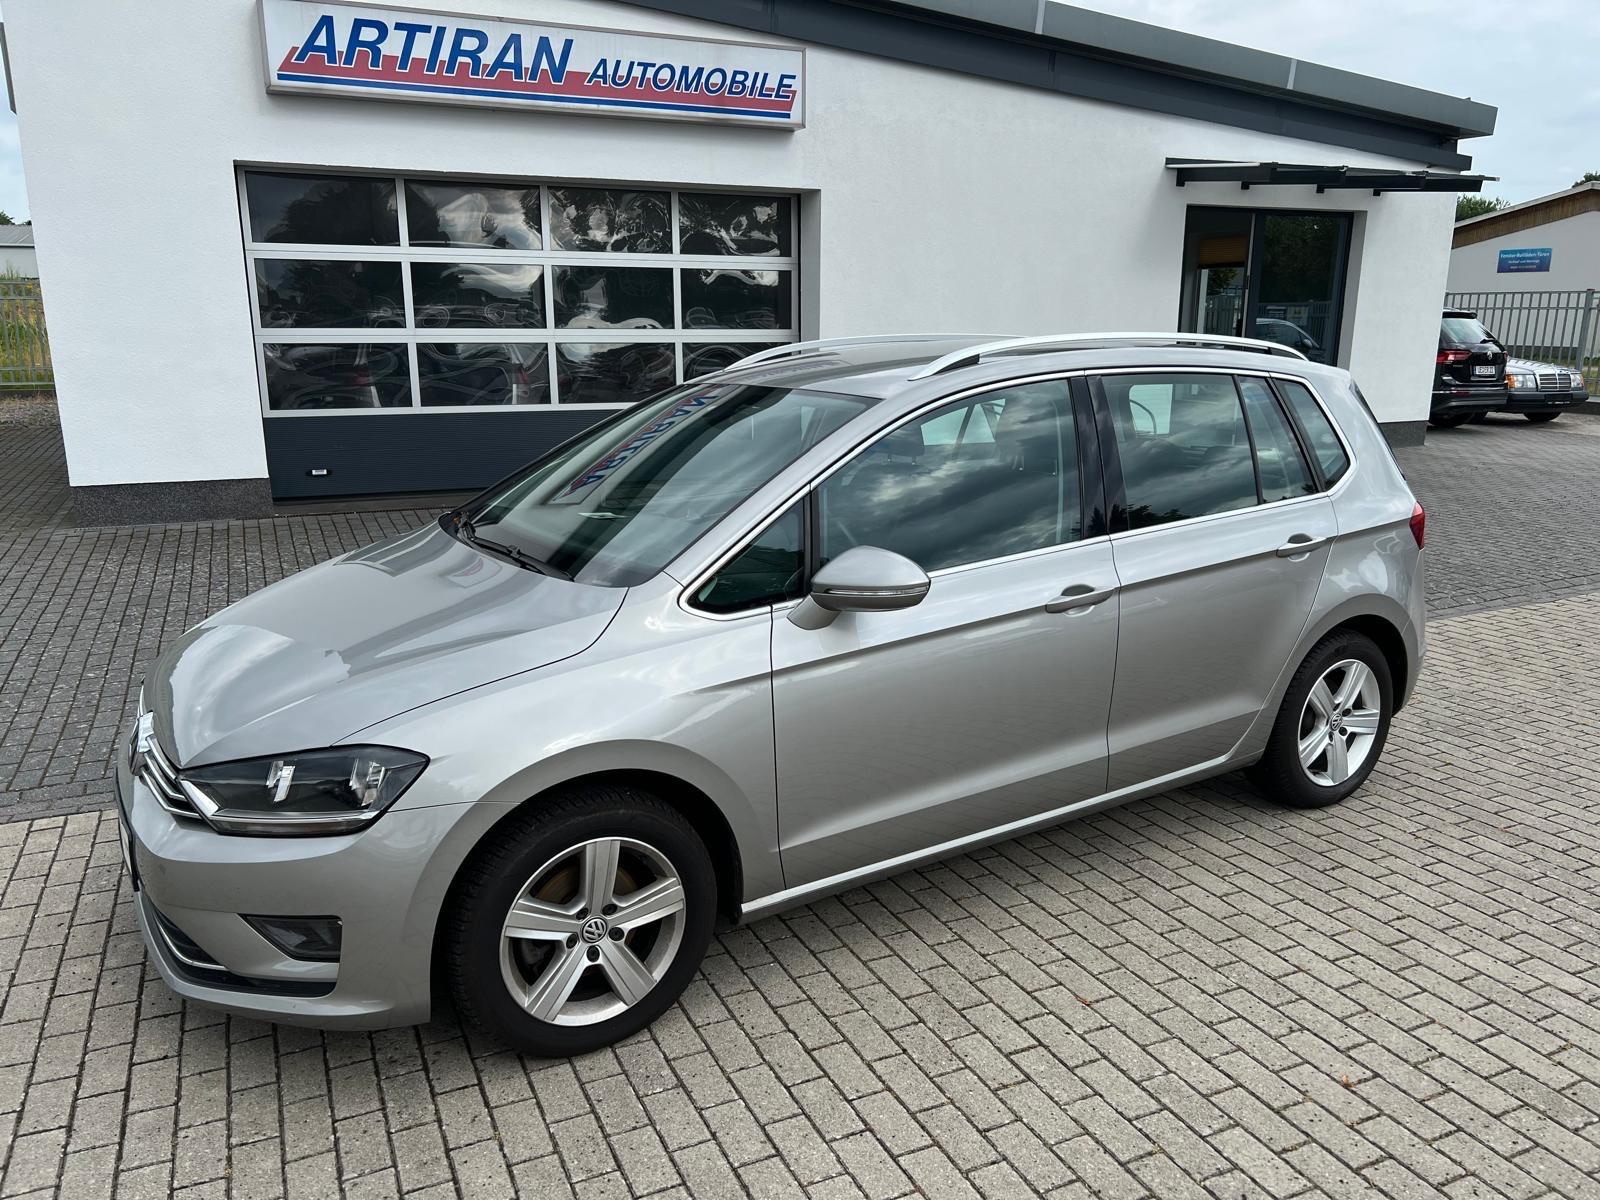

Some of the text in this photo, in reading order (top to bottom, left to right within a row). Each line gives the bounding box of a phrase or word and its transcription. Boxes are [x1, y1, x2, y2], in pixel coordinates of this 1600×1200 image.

[299, 15, 796, 100] ARTIRAN AUTOMOBILE
[583, 918, 607, 942] VW
